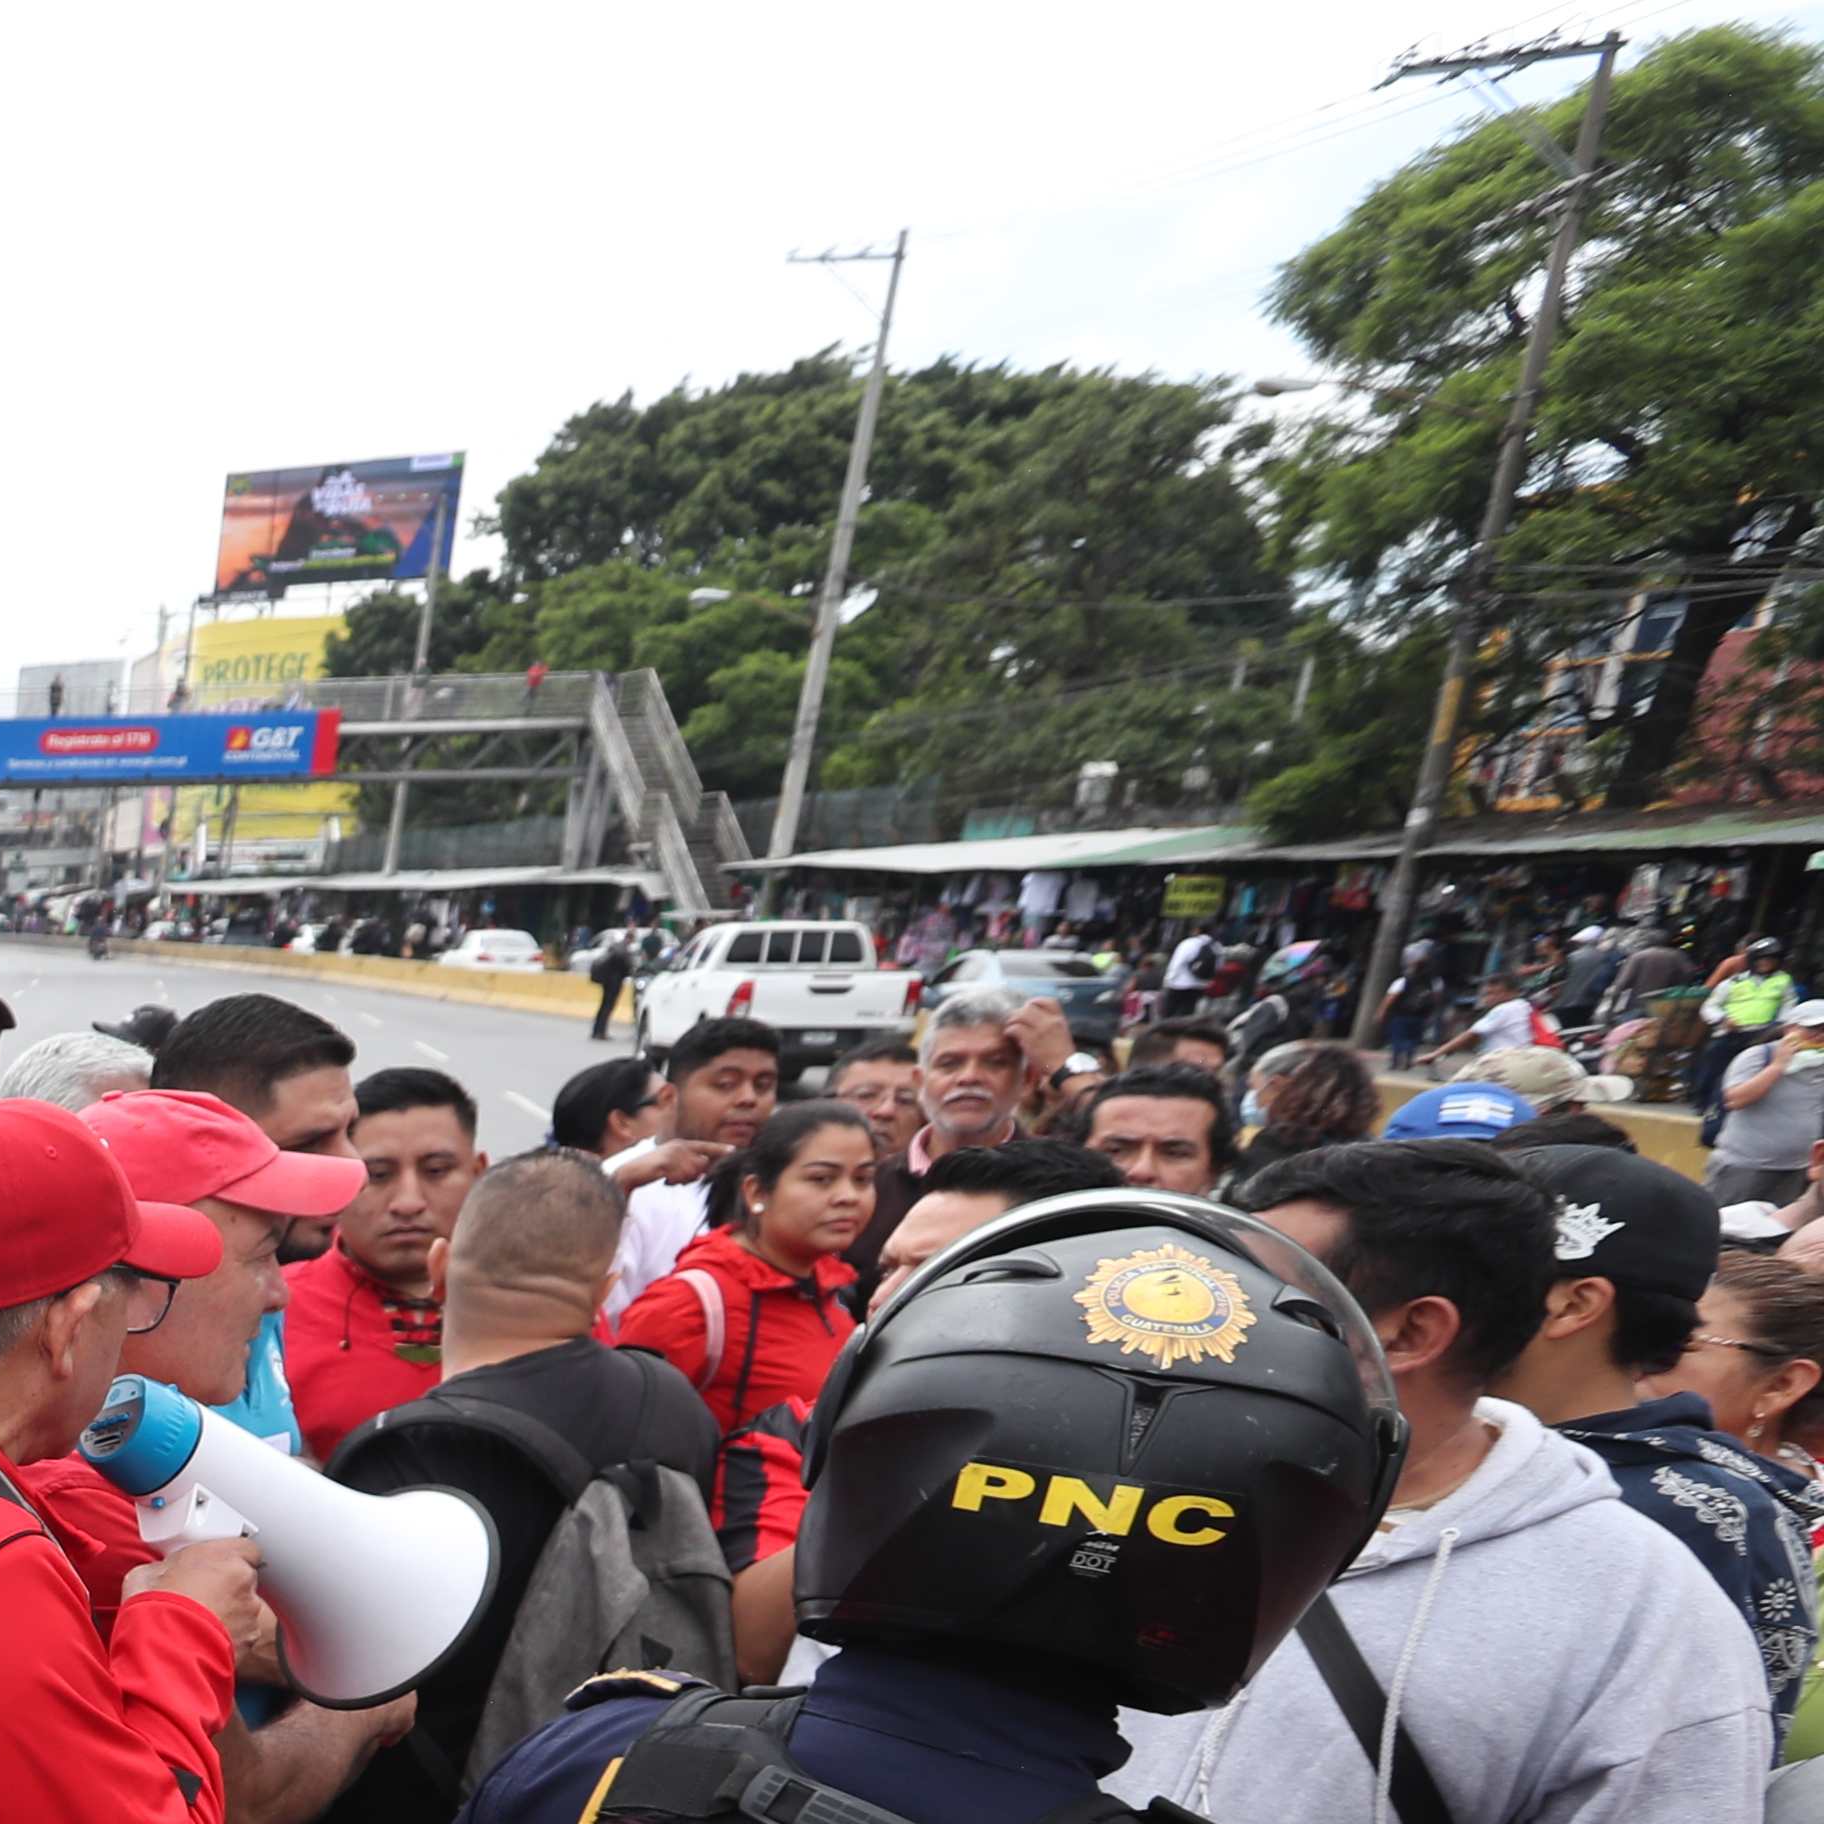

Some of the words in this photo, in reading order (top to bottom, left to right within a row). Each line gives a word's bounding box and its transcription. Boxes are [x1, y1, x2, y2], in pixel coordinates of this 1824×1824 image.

[250, 727, 304, 748] G&T
[1120, 1313, 1214, 1334] GUATEMALA
[952, 1461, 1235, 1546] PNC
[1071, 1552, 1116, 1571] DOT
